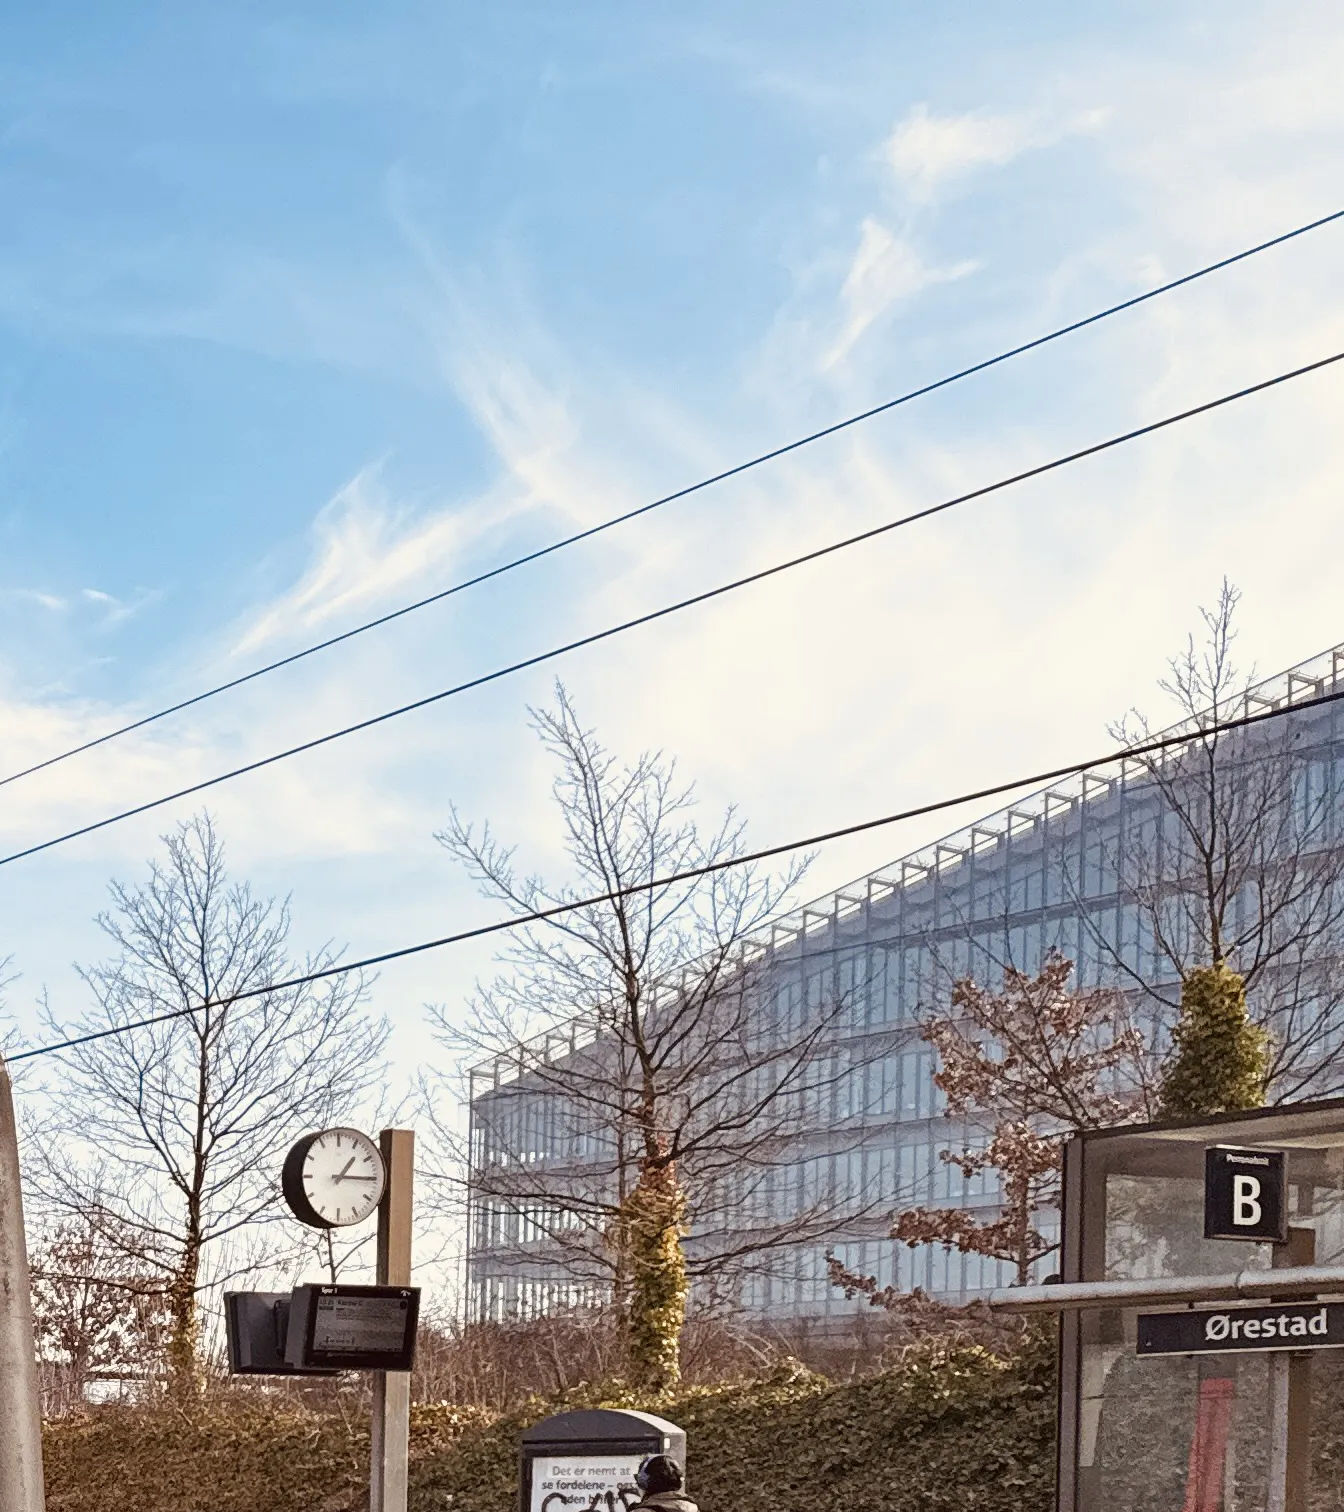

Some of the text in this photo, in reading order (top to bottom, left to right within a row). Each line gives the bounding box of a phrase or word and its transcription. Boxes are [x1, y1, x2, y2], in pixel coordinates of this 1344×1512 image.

[1233, 1174, 1262, 1226] B
[1205, 1307, 1328, 1342] Ørestad
[552, 1465, 631, 1476] Det er nemt at
[541, 1481, 553, 1490] se
[556, 1480, 605, 1490] fordelene
